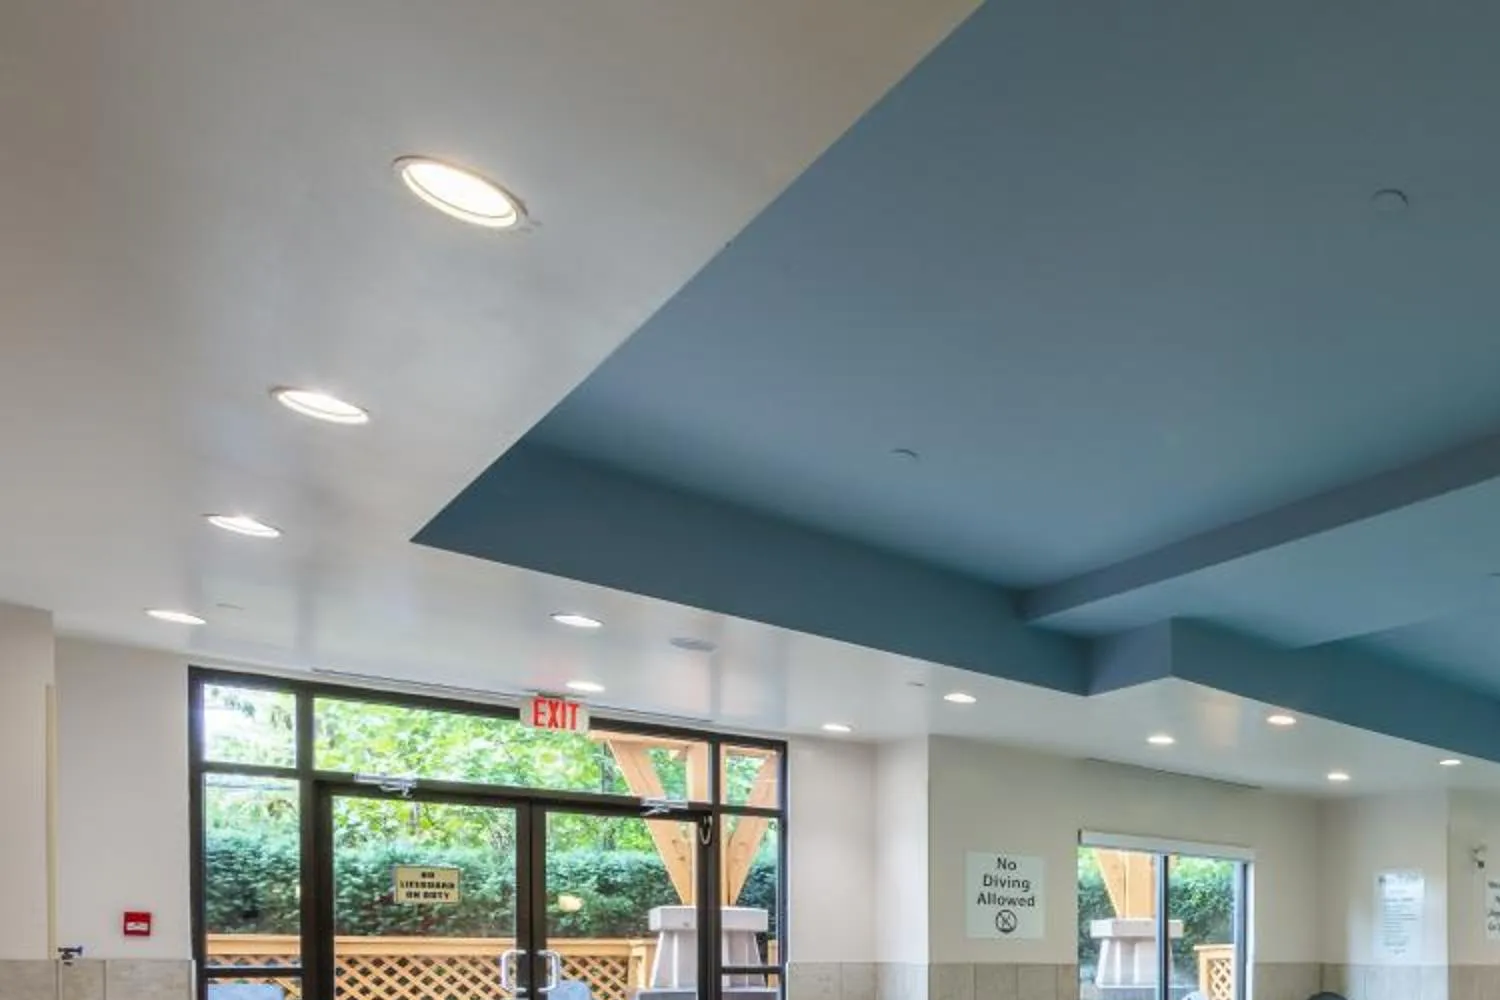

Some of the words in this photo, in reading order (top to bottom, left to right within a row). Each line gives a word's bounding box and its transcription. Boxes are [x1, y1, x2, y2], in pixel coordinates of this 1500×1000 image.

[533, 697, 579, 730] EXIT
[997, 857, 1017, 870] No
[983, 874, 1031, 892] Diving
[977, 892, 1034, 907] Allowed
